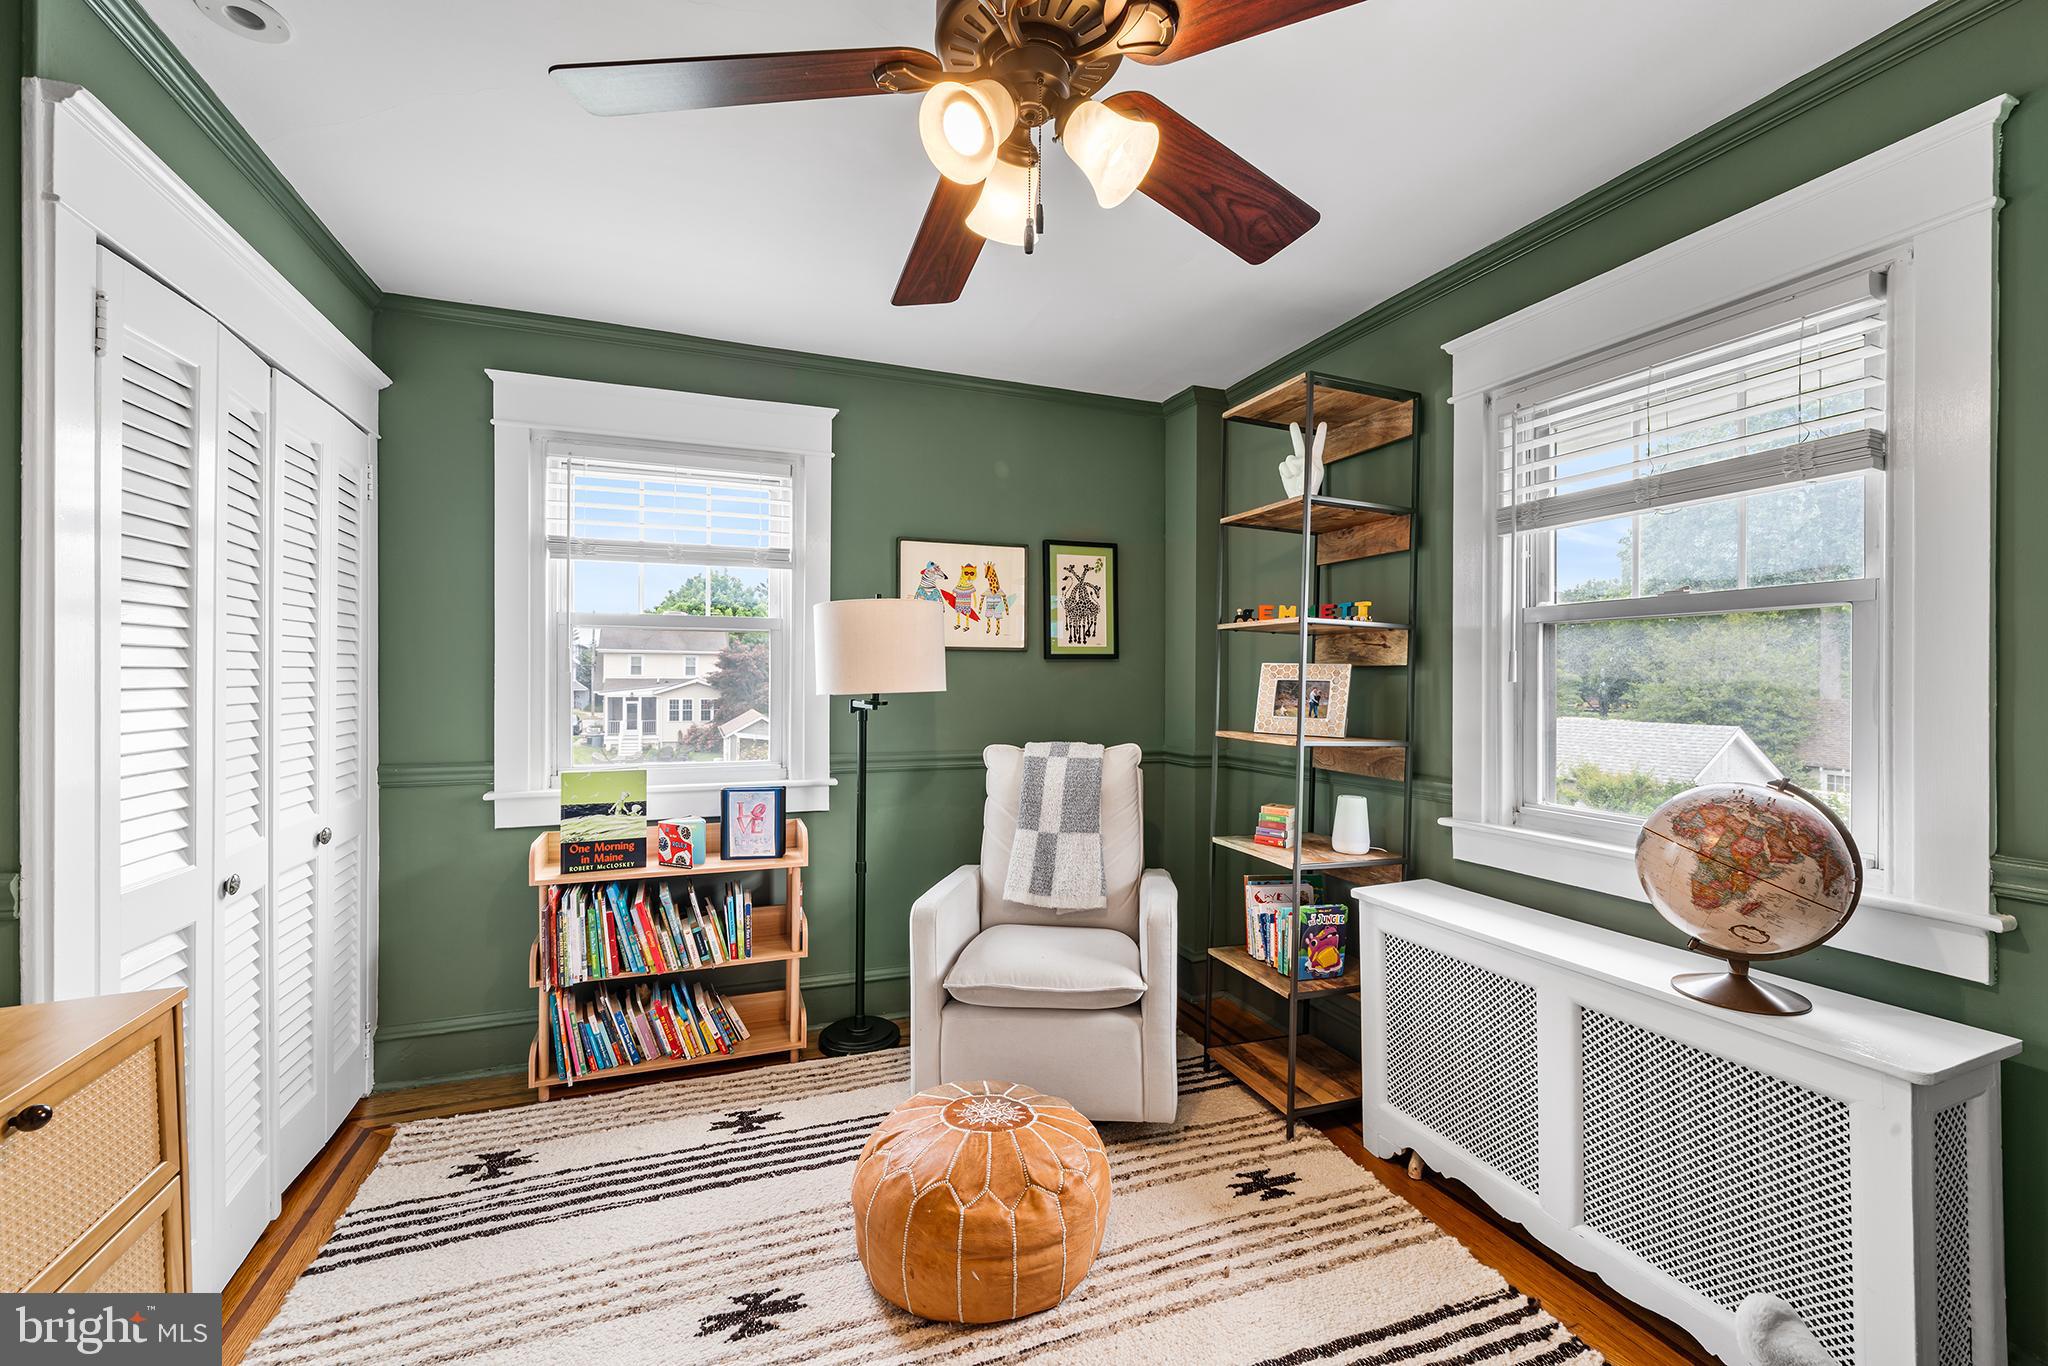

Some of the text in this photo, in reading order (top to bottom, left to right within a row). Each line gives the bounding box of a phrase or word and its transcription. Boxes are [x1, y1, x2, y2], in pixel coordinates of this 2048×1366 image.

[569, 841, 635, 854] One Morning
[580, 852, 624, 864] in Maine
[597, 861, 635, 870] McCLOSKEY
[1316, 913, 1345, 925] JUNGLE
